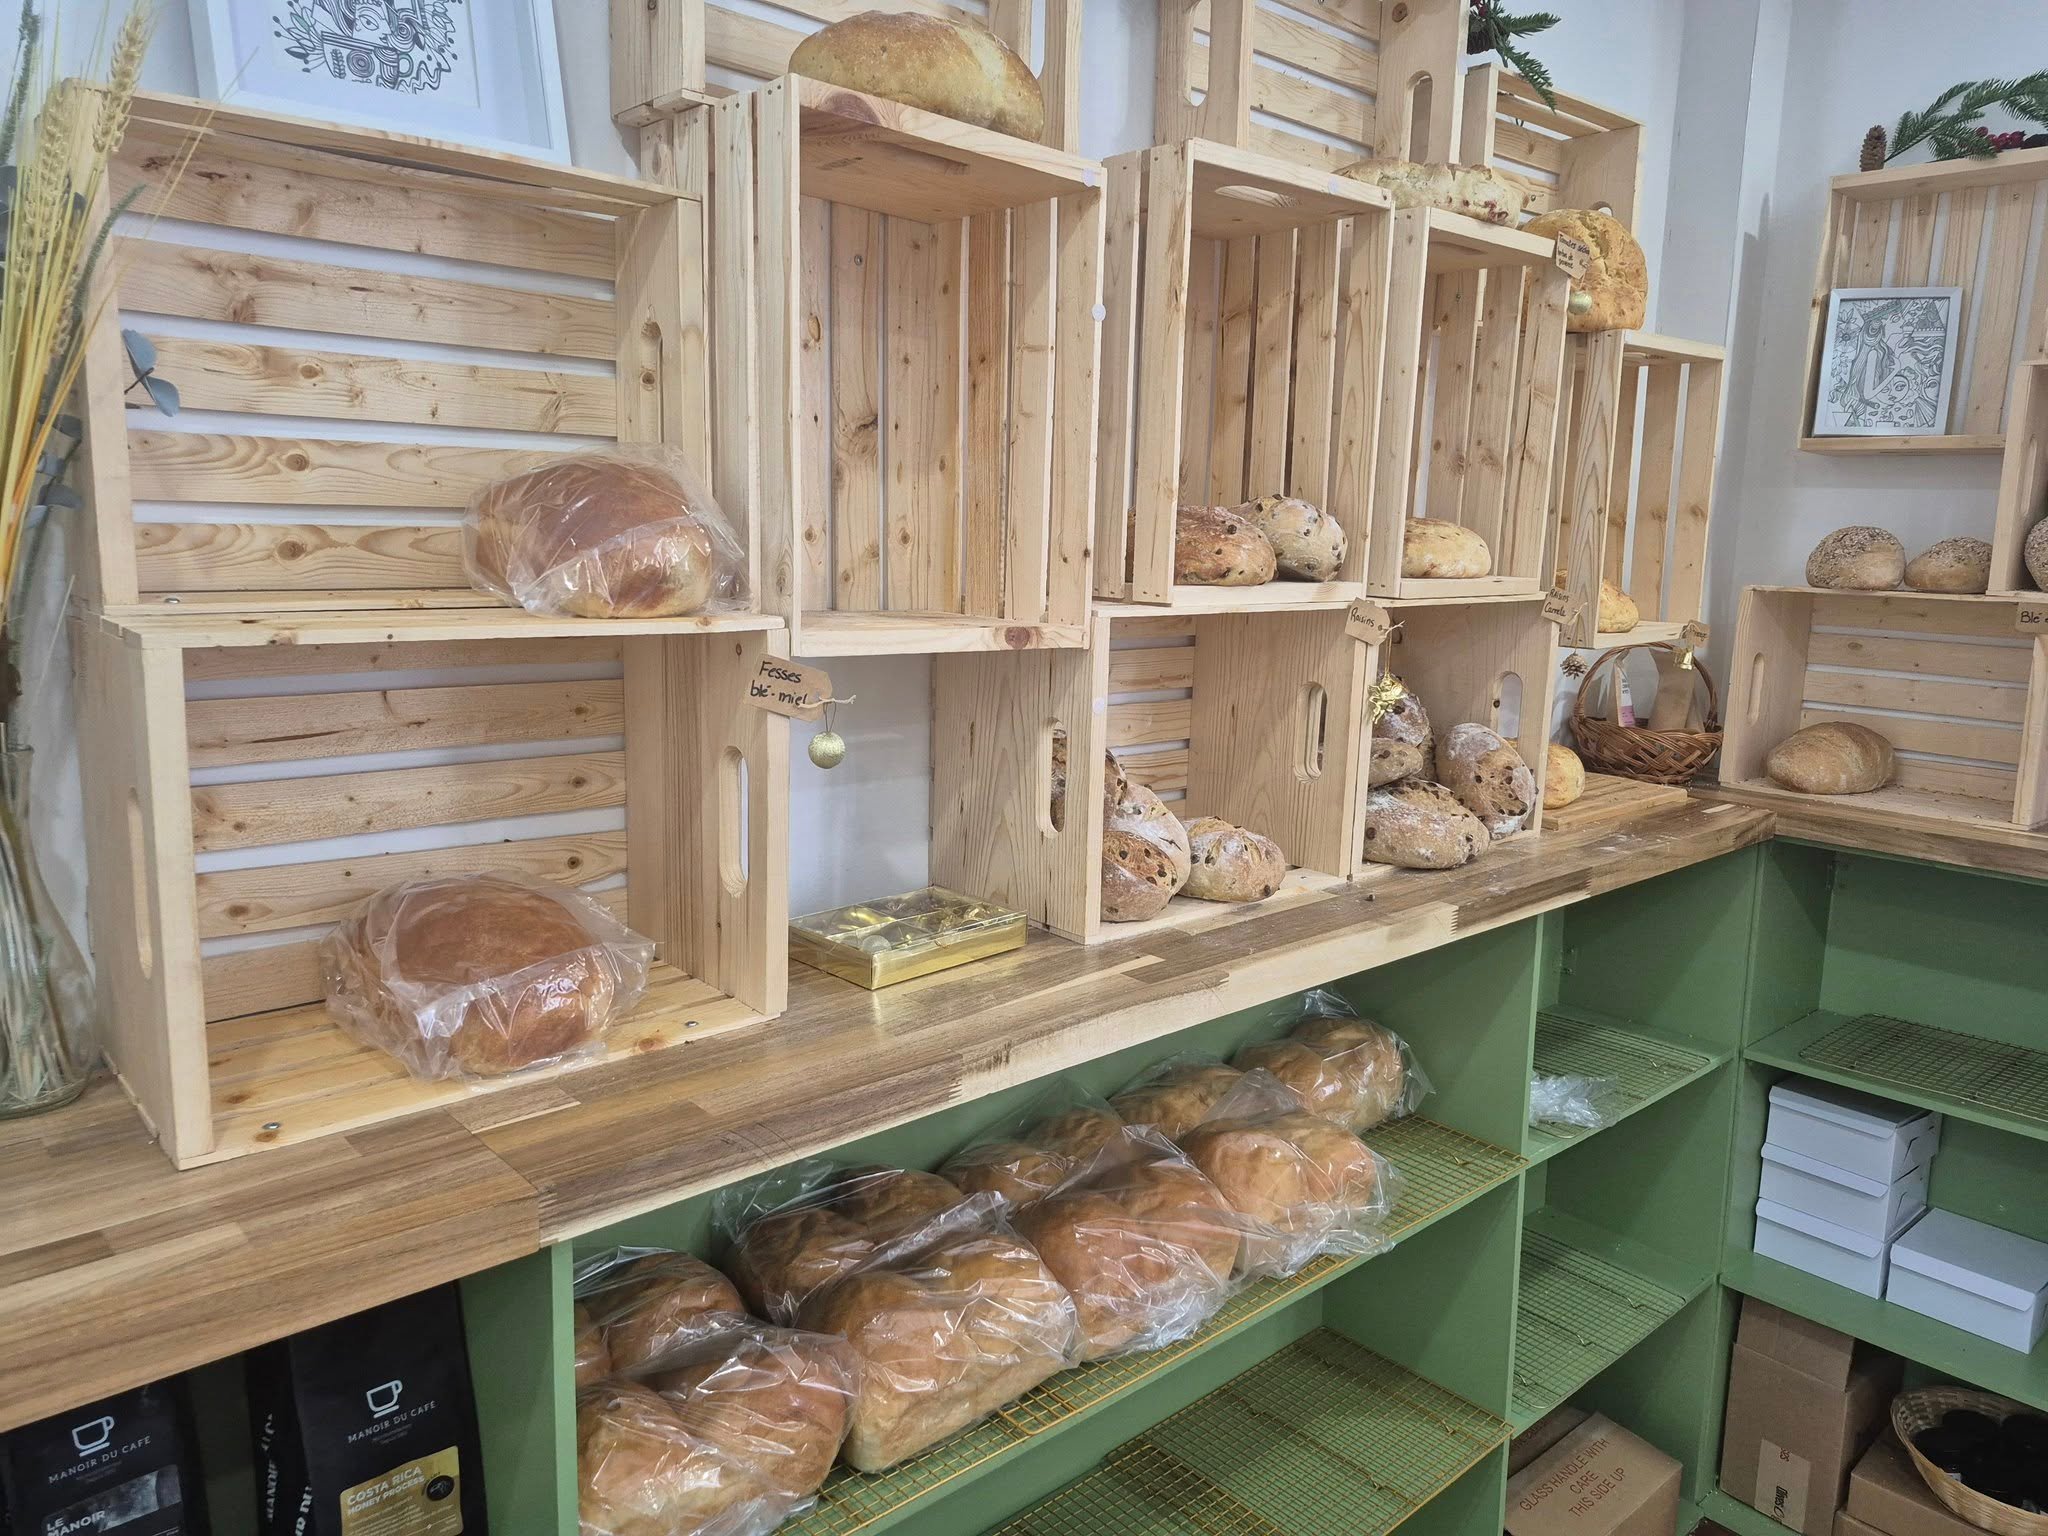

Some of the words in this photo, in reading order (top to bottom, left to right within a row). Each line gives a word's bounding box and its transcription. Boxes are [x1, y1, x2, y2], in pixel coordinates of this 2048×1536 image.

[1350, 606, 1375, 628] Raisins
[2019, 610, 2043, 624] Blé
[758, 660, 802, 683] Fesses
[347, 1419, 391, 1443] MANOIR
[393, 1412, 408, 1425] DU
[47, 1458, 98, 1484] MANOIR
[101, 1449, 119, 1463] DU
[1519, 1483, 1554, 1512] GLASS
[1551, 1454, 1588, 1489] HANDLE
[1585, 1437, 1610, 1462] WITH
[347, 1481, 390, 1506] COSTA
[391, 1466, 423, 1487] RICA
[348, 1493, 382, 1516] HONEY
[382, 1474, 425, 1501] PROCESS
[1568, 1497, 1595, 1518] THIS
[1593, 1478, 1616, 1501] SIDE
[1612, 1467, 1626, 1482] UP
[1570, 1470, 1600, 1495] CARE
[46, 1517, 65, 1532] LE
[47, 1510, 106, 1536] MANOIR
